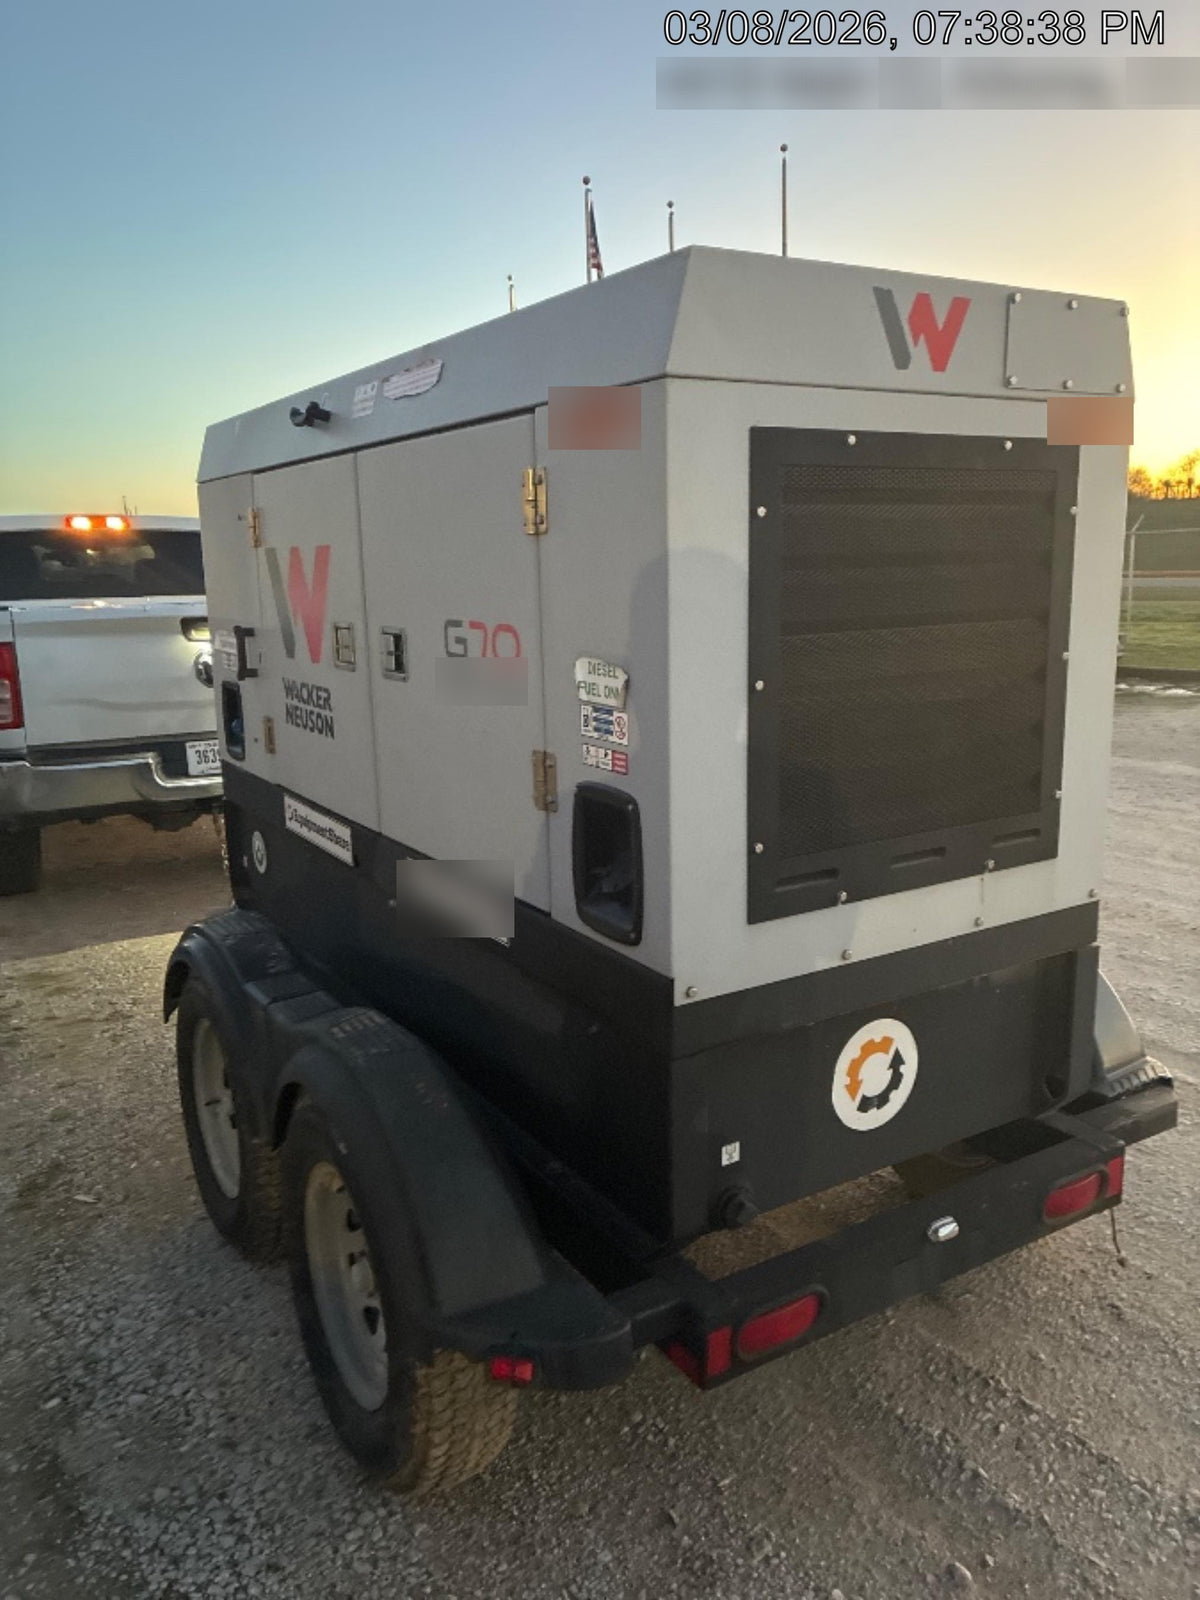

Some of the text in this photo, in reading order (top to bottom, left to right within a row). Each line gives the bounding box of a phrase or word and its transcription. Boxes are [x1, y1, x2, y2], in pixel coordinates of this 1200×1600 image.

[444, 619, 521, 658] G70
[587, 660, 619, 679] DIESEL
[282, 676, 333, 713] WACKER
[577, 680, 602, 698] FUEL
[285, 702, 335, 741] NEUSON
